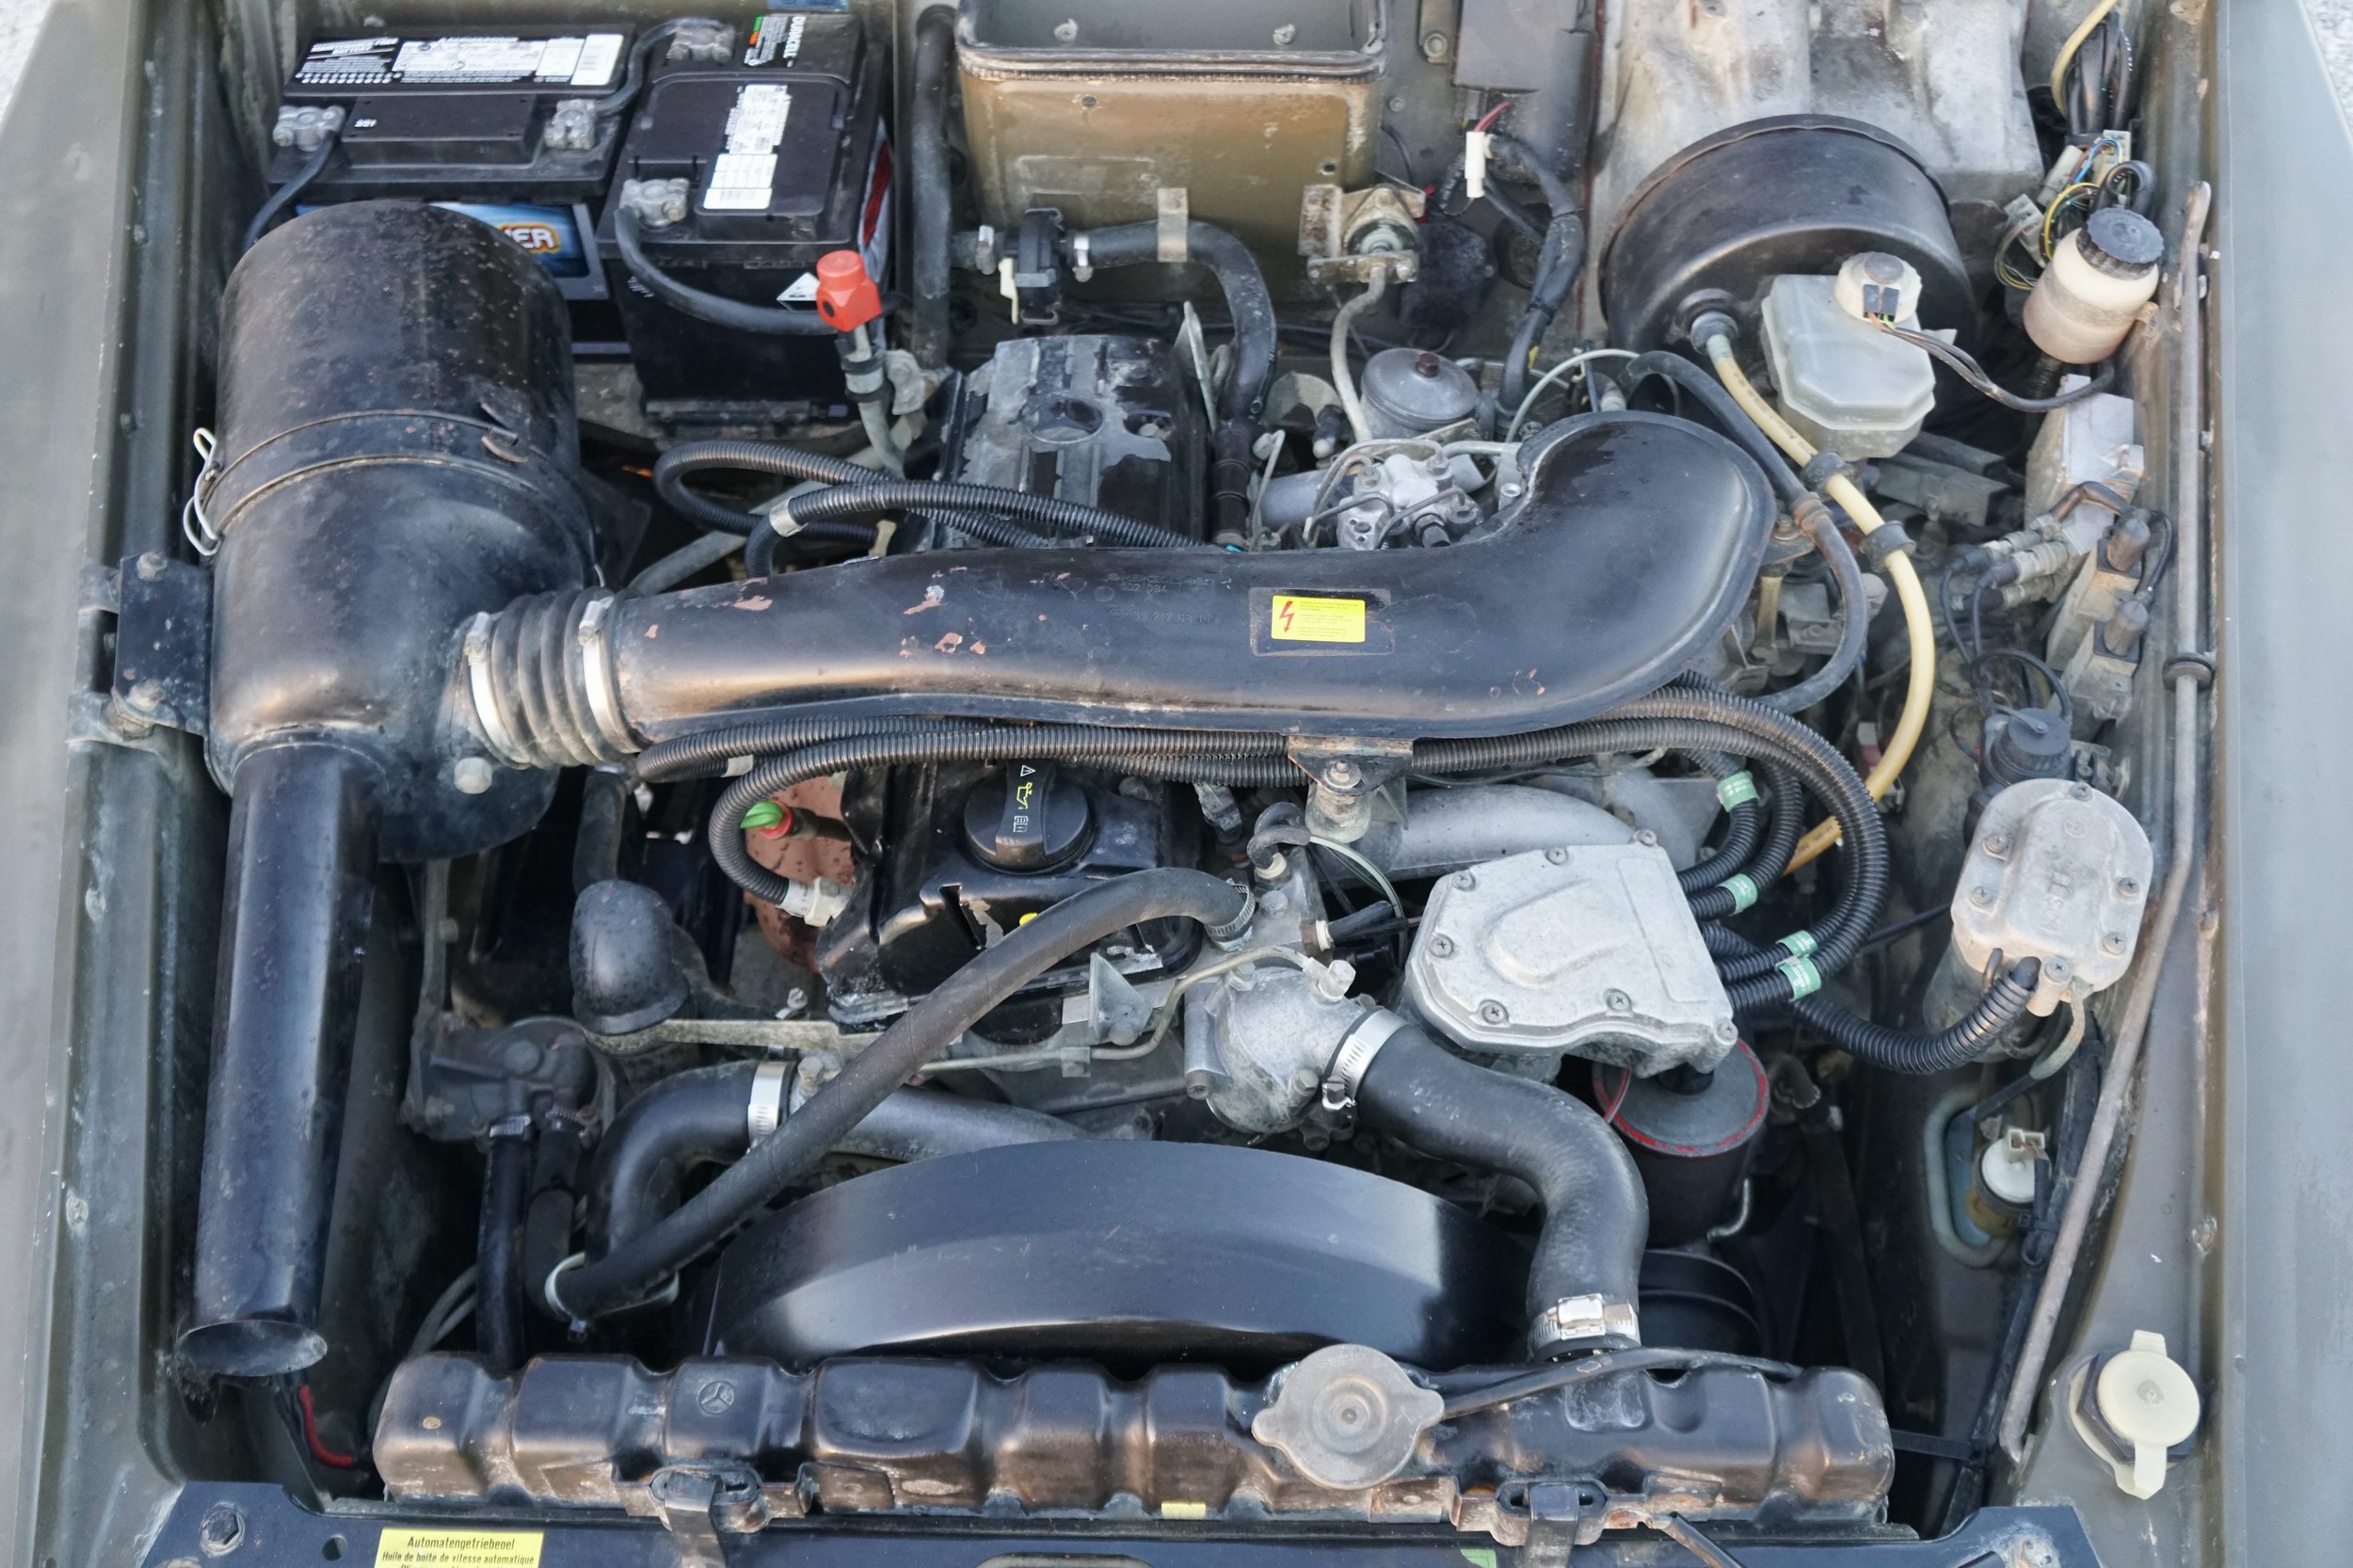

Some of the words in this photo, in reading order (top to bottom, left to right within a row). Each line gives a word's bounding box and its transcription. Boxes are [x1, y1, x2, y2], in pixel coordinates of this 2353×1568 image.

[783, 15, 807, 59] DURACELL
[504, 227, 554, 249] ER
[407, 1536, 516, 1551] Automatengetriebeoel
[381, 1551, 402, 1562] Huile
[404, 1552, 414, 1562] de
[439, 1553, 449, 1563] de
[452, 1554, 482, 1564] vitesse
[483, 1555, 536, 1566] automatique
